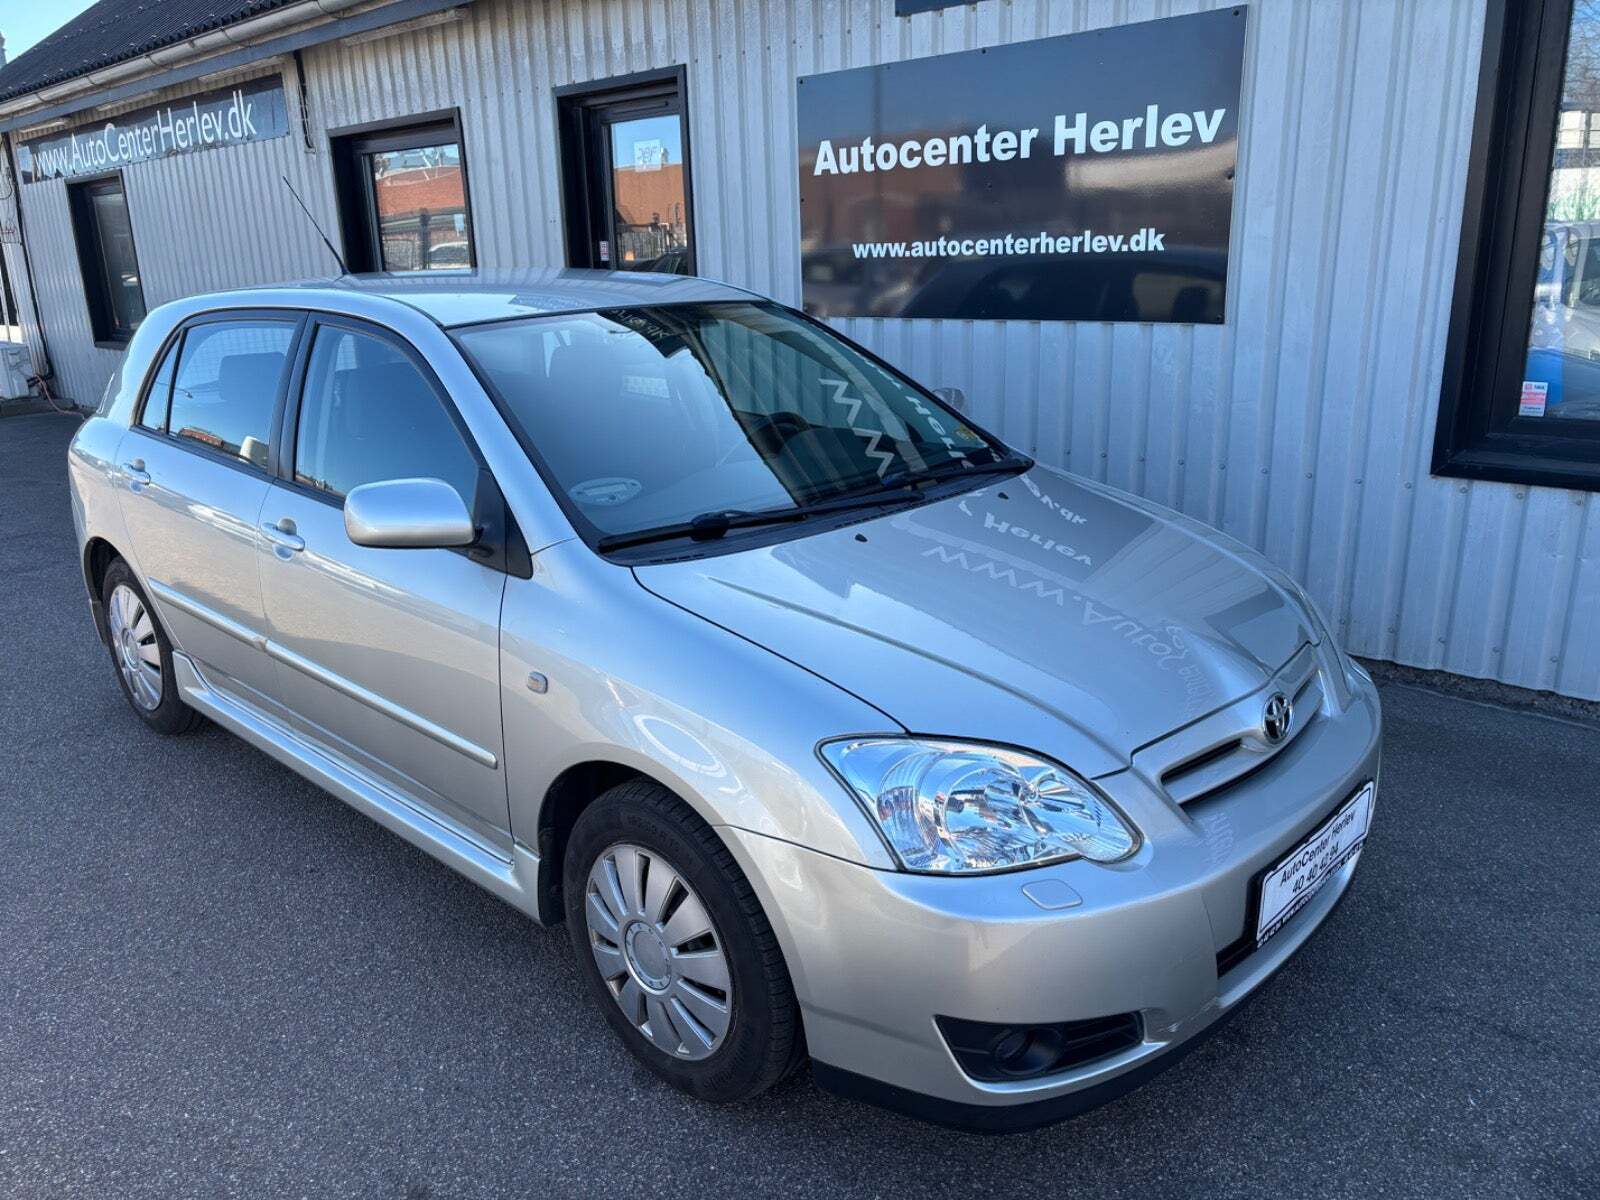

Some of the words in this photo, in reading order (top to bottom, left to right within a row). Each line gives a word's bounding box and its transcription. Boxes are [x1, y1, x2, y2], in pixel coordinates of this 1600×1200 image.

[35, 90, 257, 173] www.AutoCenterHerlev.dk
[813, 124, 1040, 176] Autocenter
[1053, 104, 1226, 156] Herlev
[852, 228, 1166, 259] www.autocenterherlev.dk
[1280, 838, 1330, 884] AutoCenter
[1332, 812, 1354, 835] Herlev
